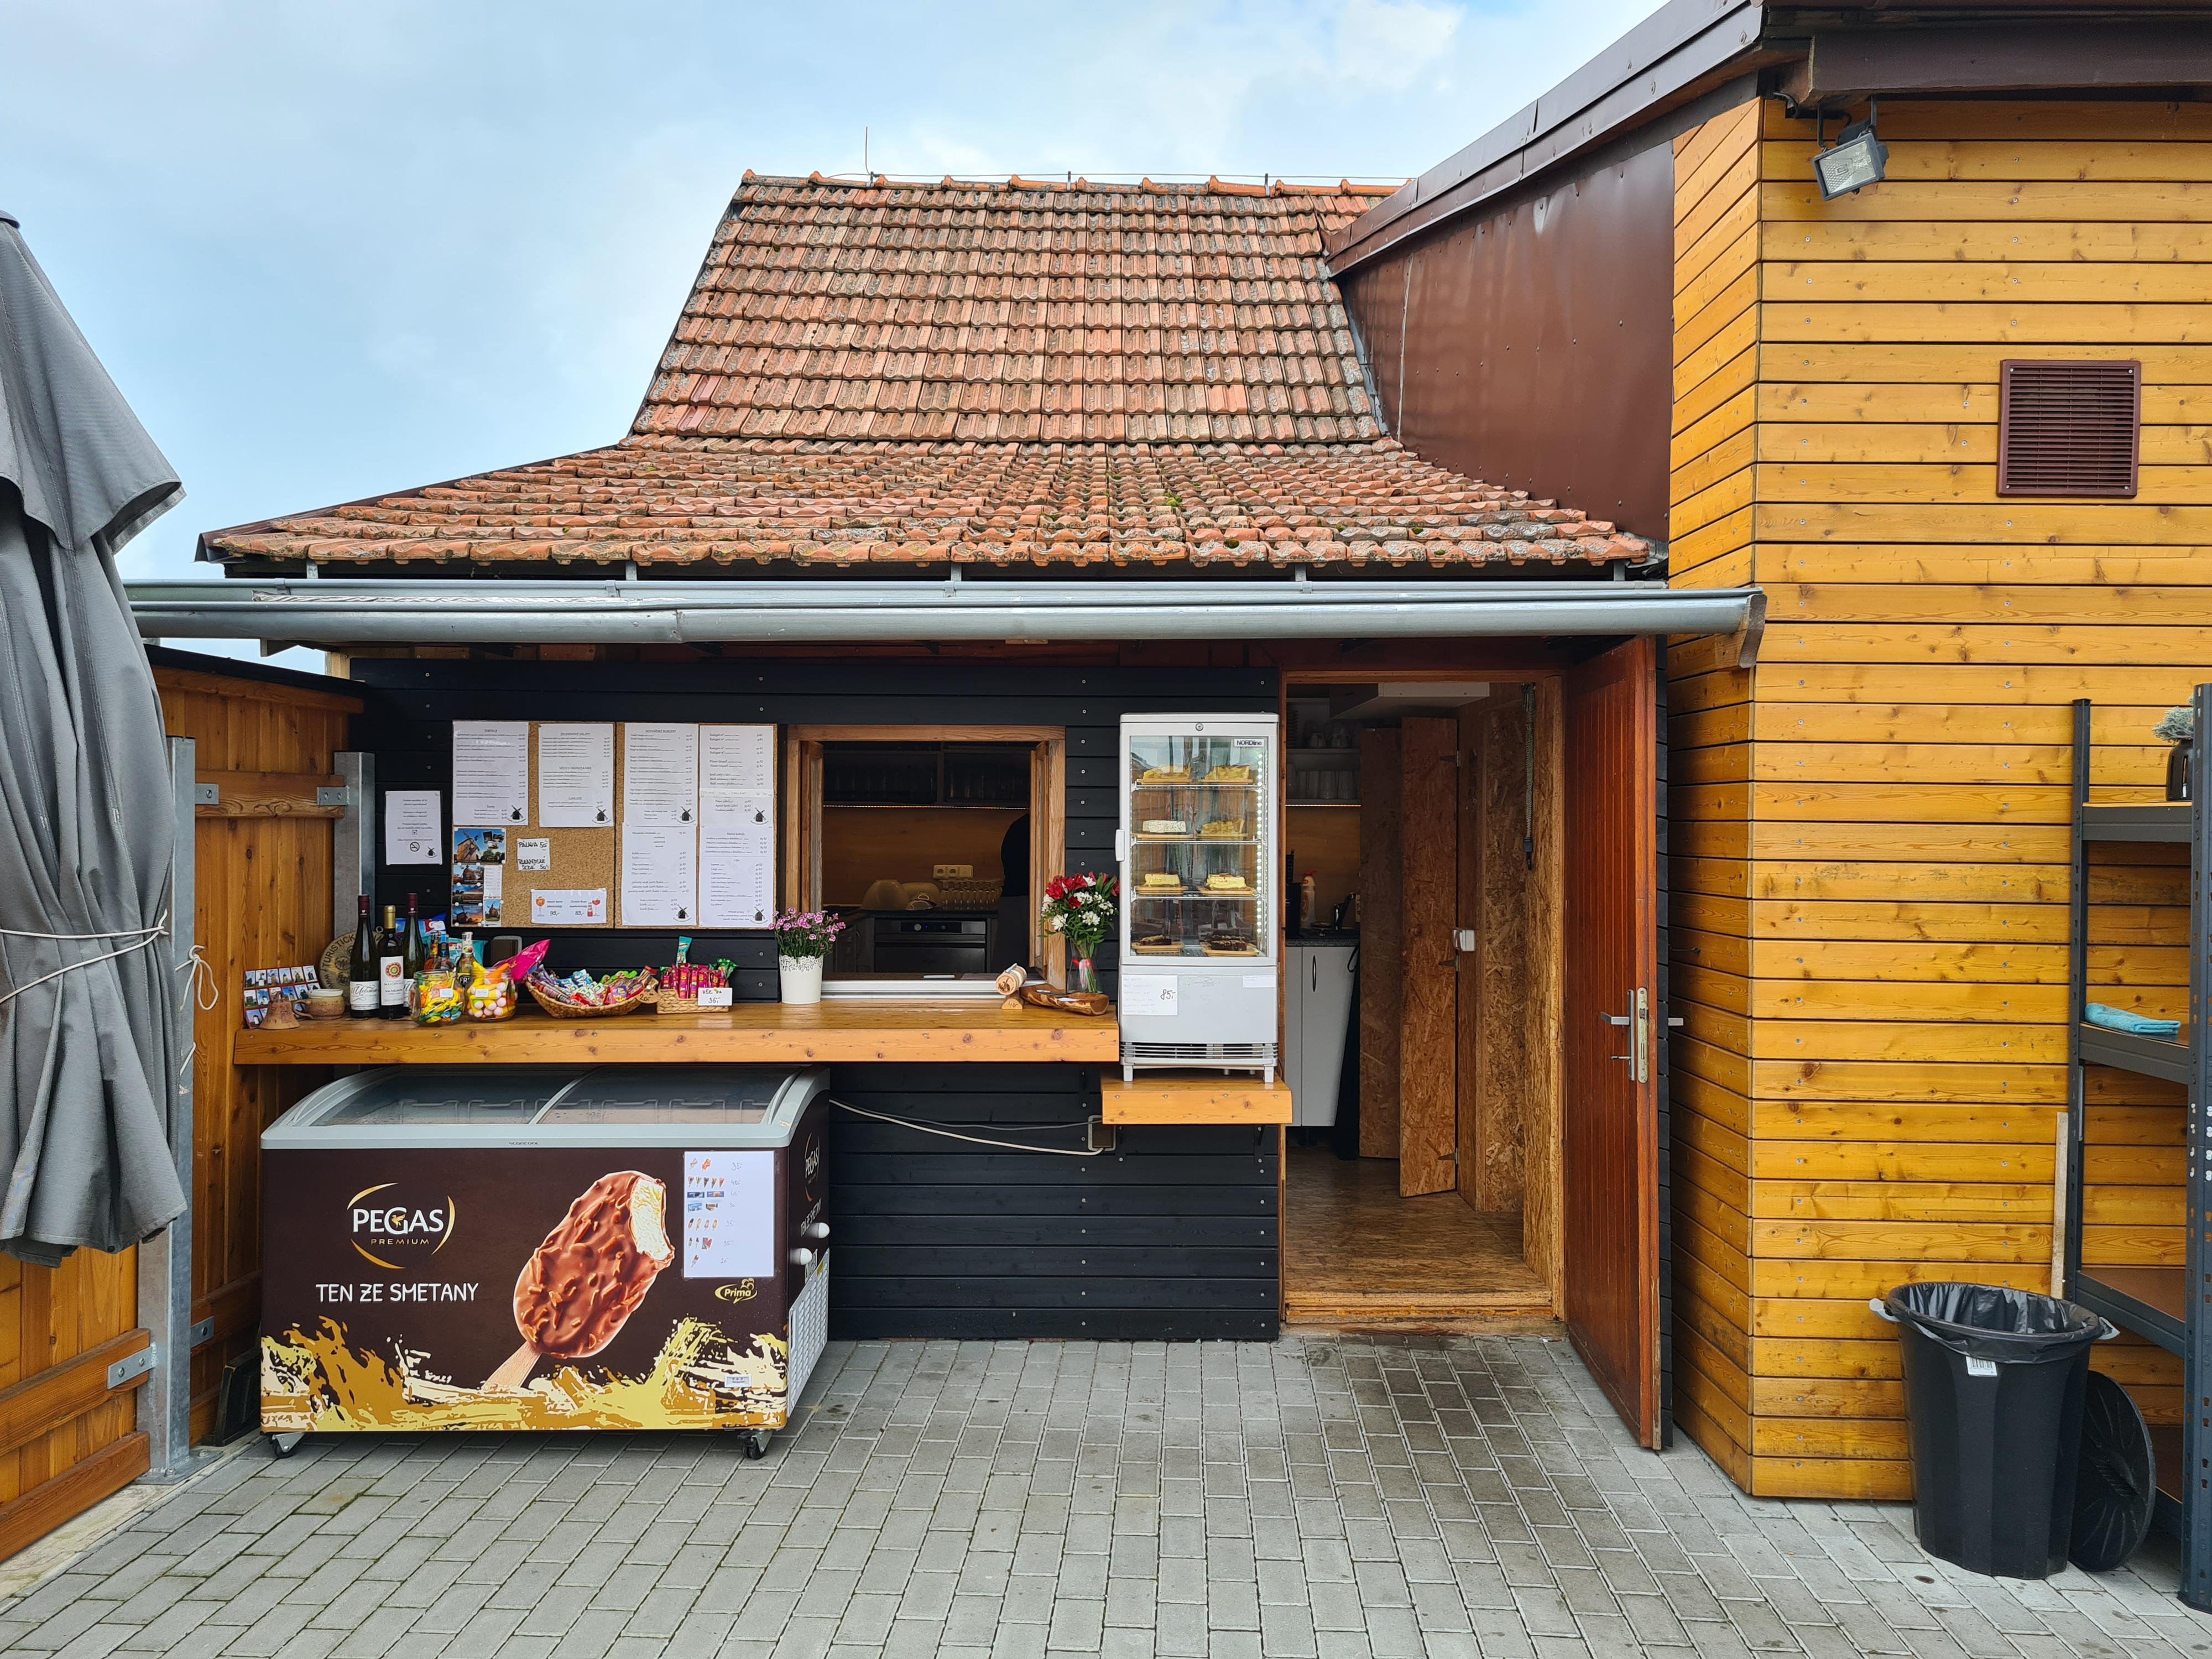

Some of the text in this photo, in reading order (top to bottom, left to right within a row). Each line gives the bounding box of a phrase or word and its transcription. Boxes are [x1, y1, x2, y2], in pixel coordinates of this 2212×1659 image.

[322, 933, 356, 967] TURISTICK
[805, 1146, 818, 1179] PEGAS
[352, 1207, 444, 1235] PEGAS
[315, 1283, 479, 1302] TEN ZE SMETANY
[724, 1288, 752, 1297] Prima
